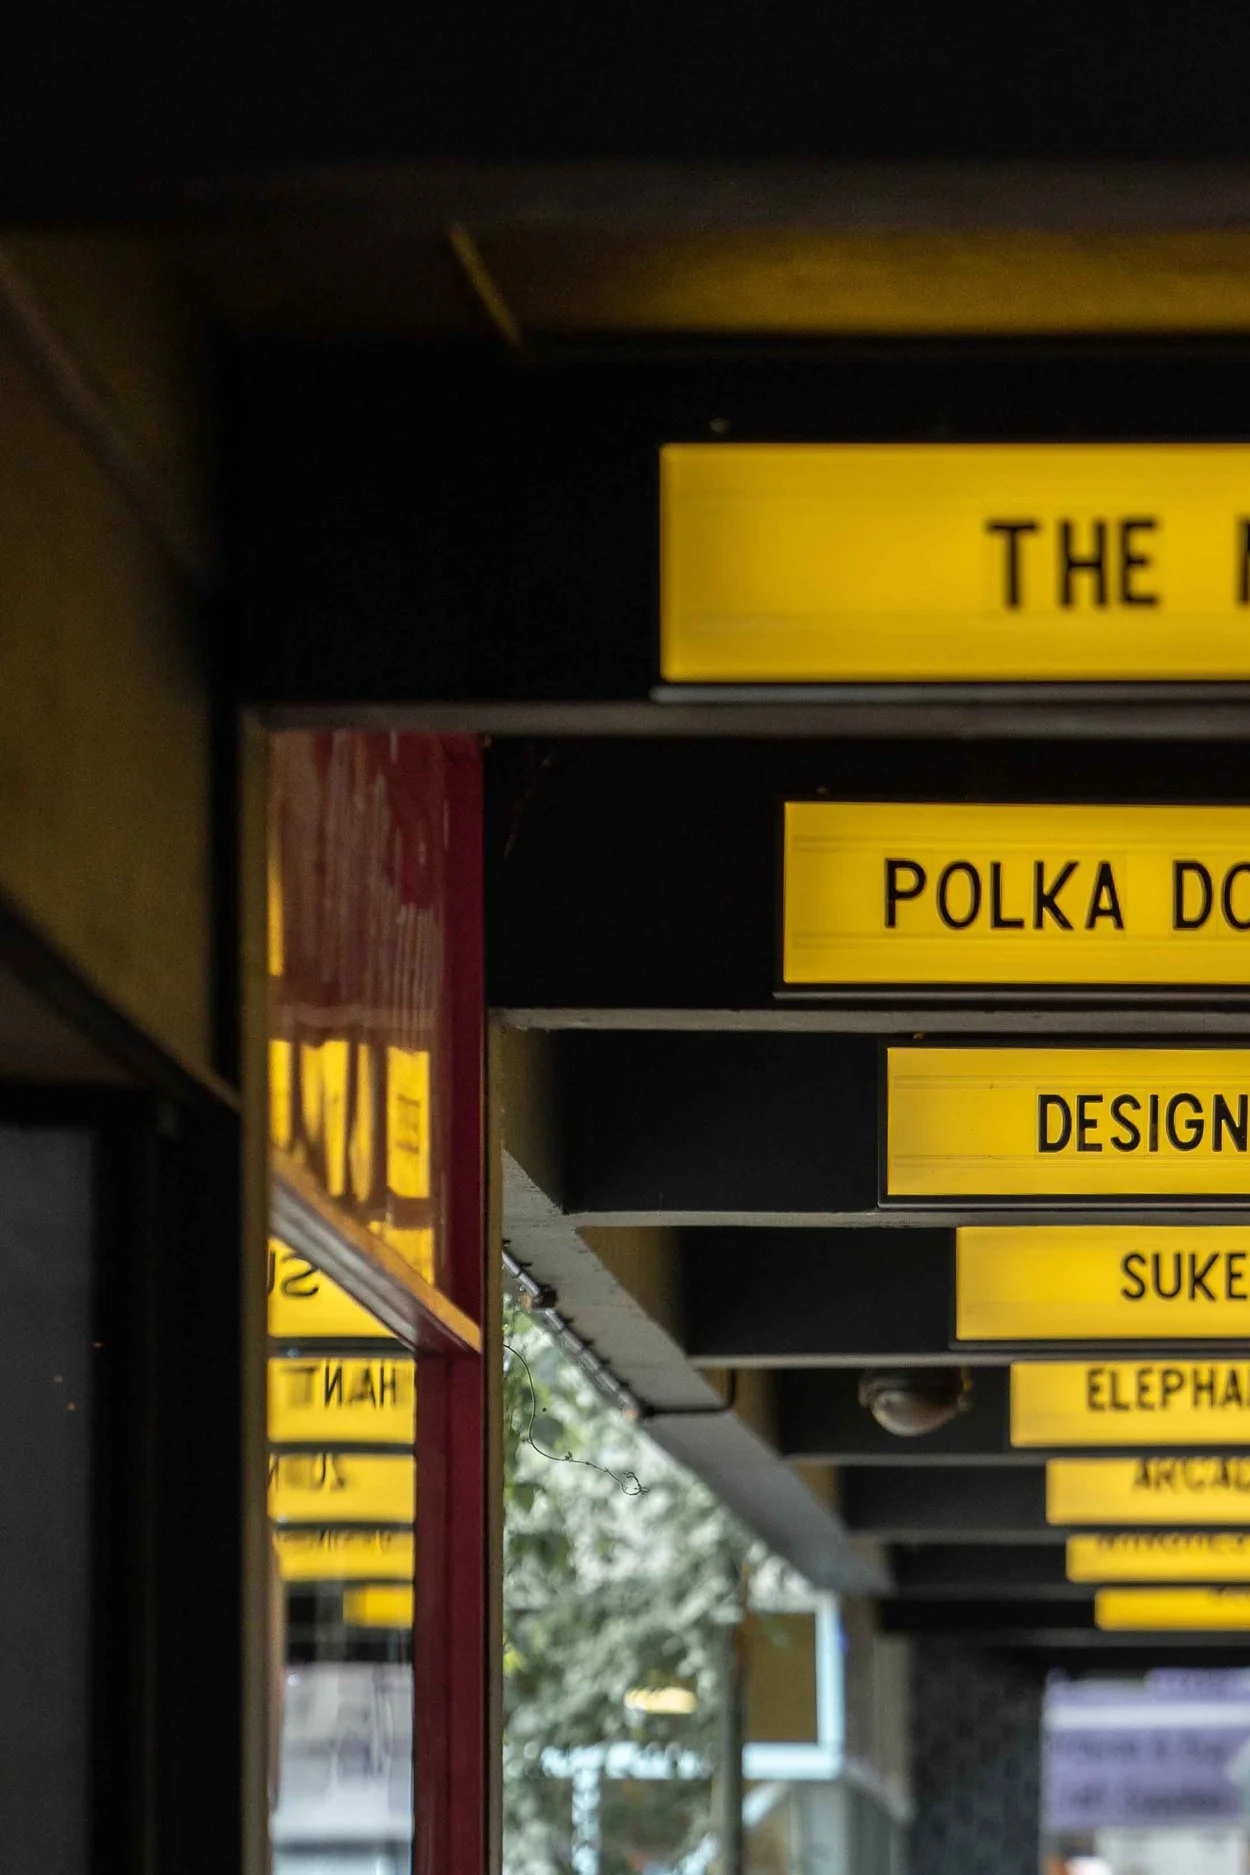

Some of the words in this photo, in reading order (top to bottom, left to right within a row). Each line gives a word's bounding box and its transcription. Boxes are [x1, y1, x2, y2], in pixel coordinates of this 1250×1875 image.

[986, 517, 1159, 611] THE
[884, 858, 1124, 931] POLKA
[1038, 1093, 1249, 1152] DESIGN
